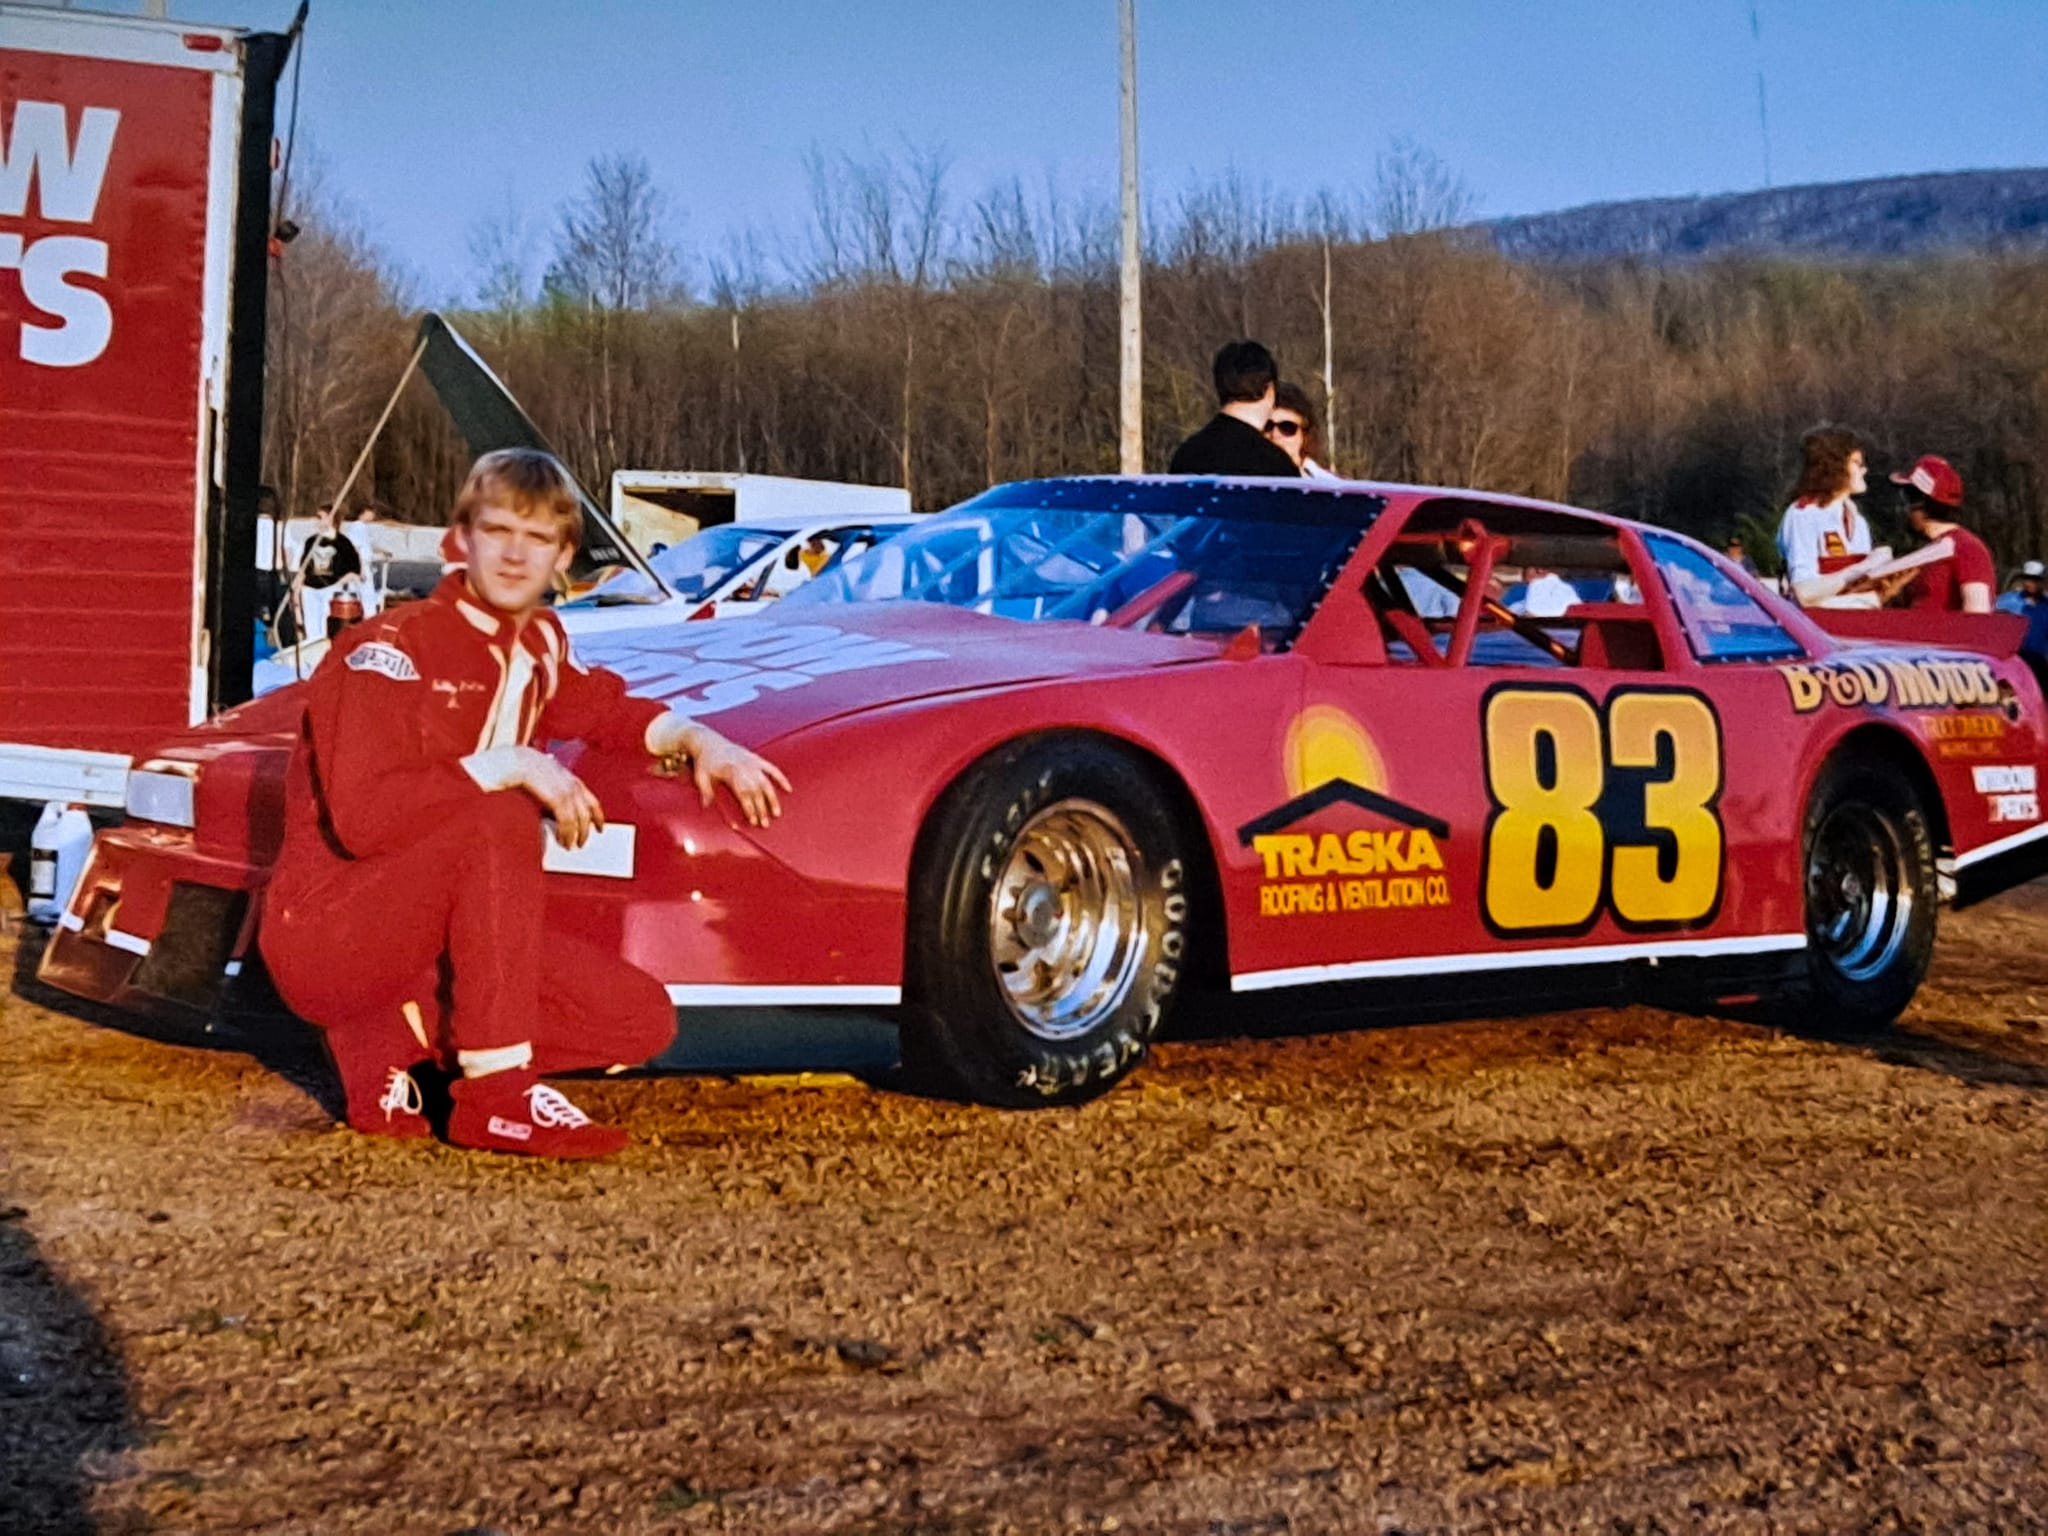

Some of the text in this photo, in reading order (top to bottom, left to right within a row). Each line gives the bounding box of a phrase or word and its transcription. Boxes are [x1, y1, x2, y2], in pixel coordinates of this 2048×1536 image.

[1481, 681, 1724, 938] 83
[1253, 828, 1444, 879] TRASKA
[1260, 883, 1324, 916] ROOFING
[1339, 876, 1425, 910] VENTILATION
